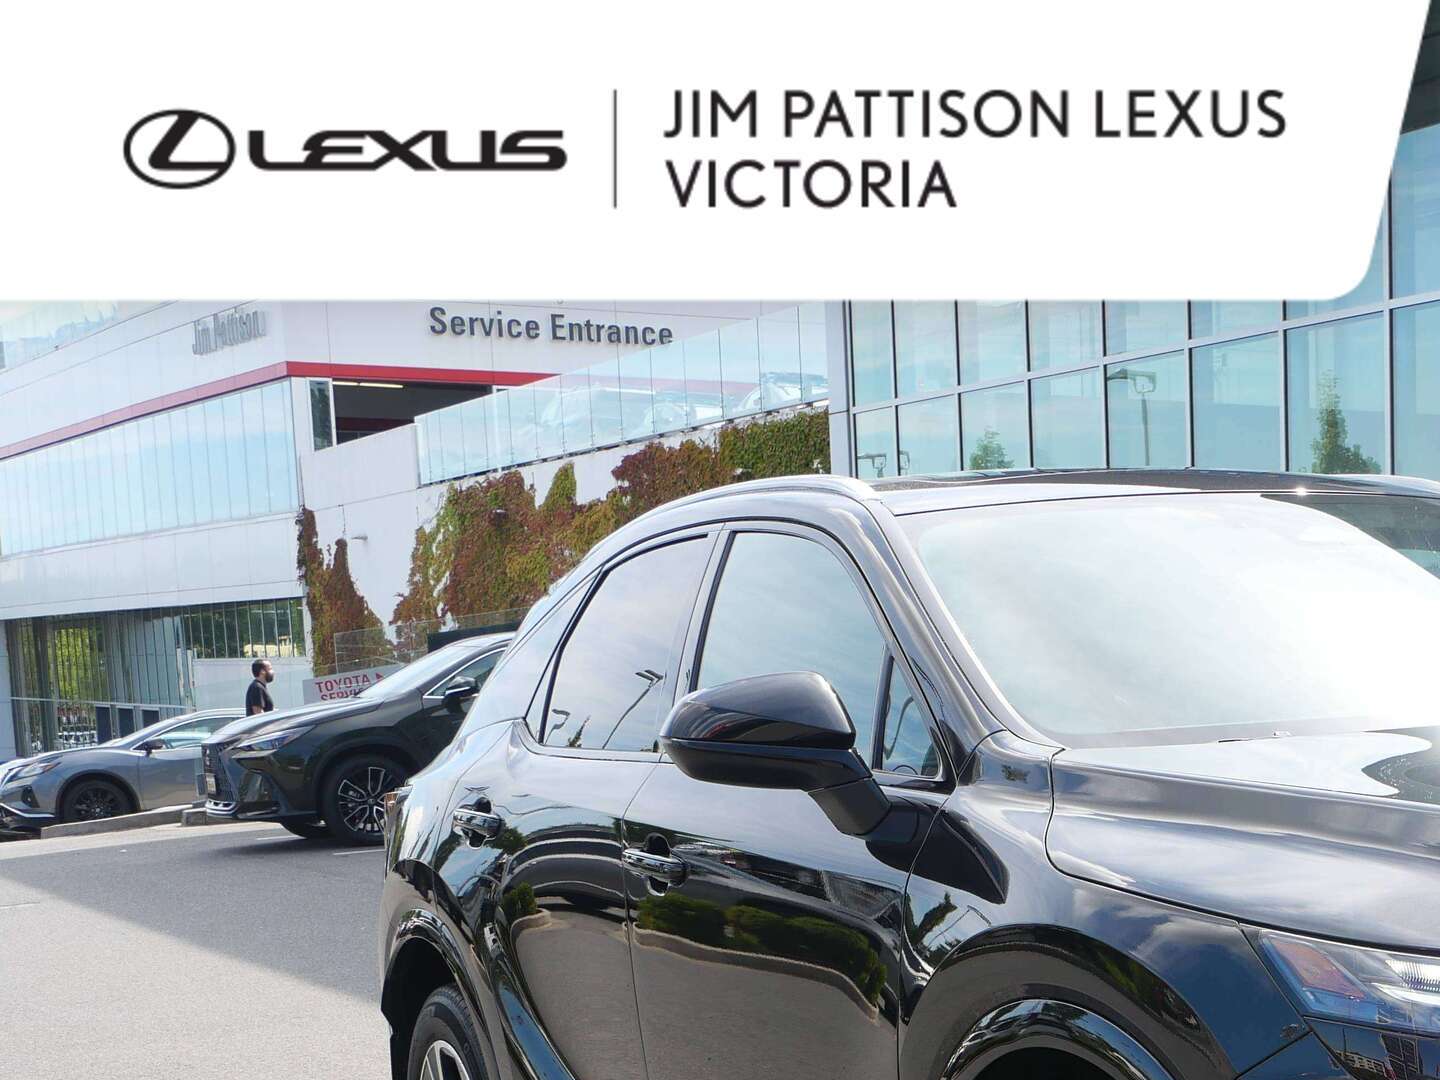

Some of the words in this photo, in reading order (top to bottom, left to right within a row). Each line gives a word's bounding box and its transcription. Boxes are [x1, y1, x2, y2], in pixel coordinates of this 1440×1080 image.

[429, 306, 541, 340] Service
[550, 313, 674, 346] Entrance
[315, 673, 371, 694] TOYOTA
